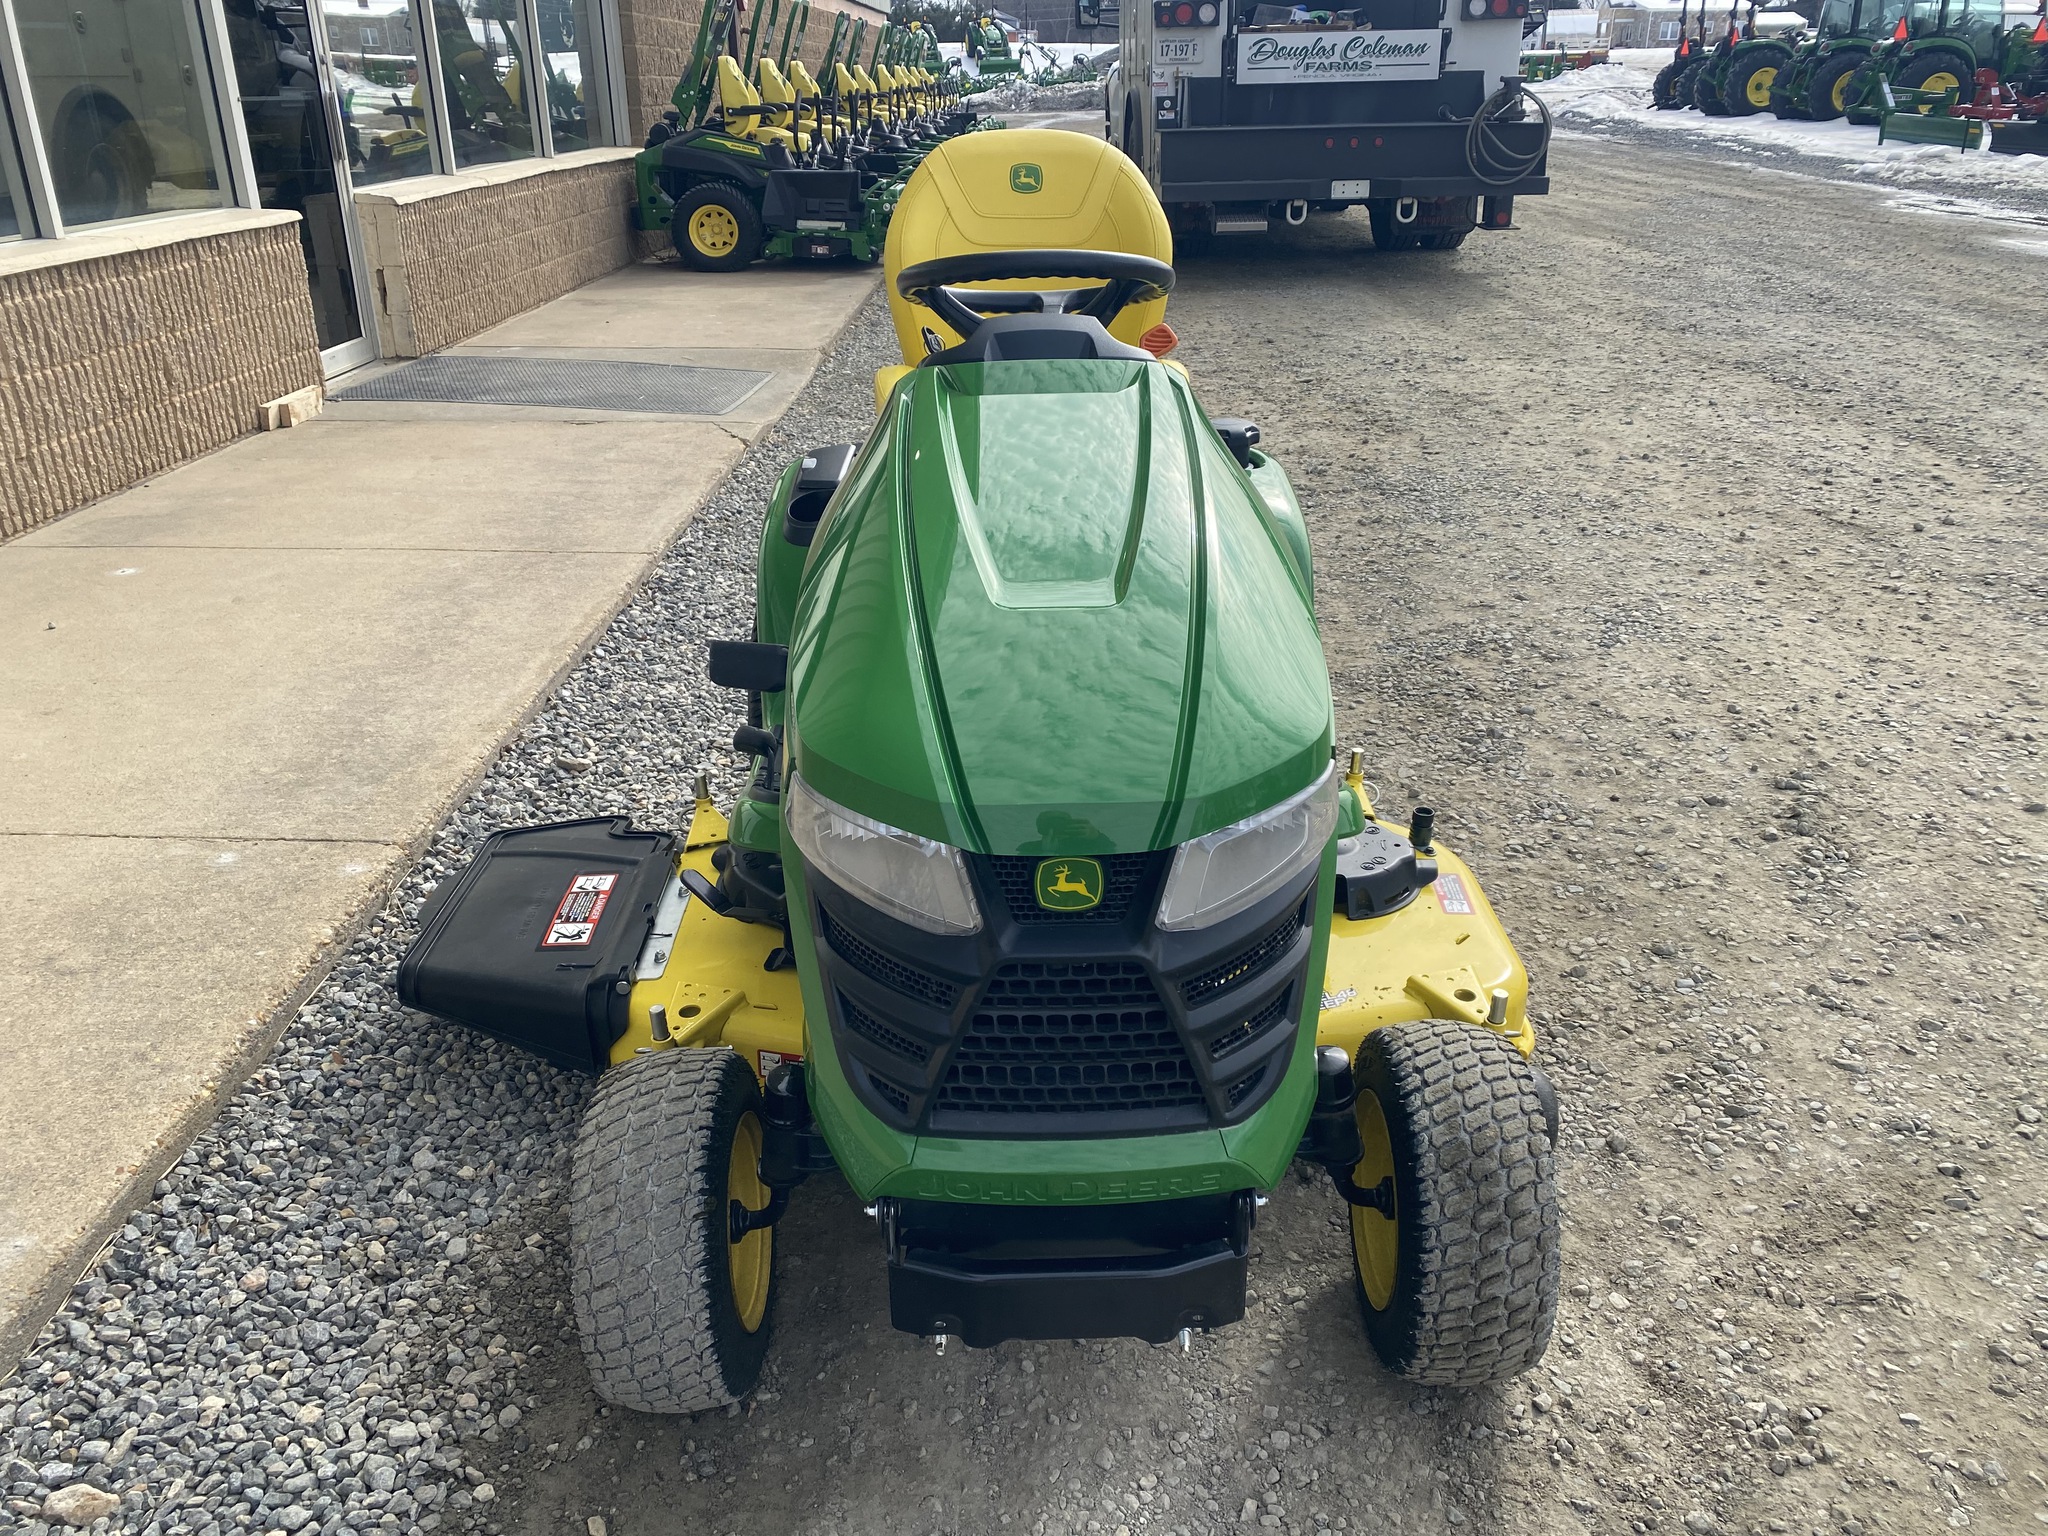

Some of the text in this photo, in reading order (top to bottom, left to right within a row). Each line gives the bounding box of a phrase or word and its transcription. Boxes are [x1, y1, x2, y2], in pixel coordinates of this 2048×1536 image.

[1160, 44, 1190, 57] 17-197
[1248, 35, 1431, 68] Douglas Coleman
[1303, 60, 1373, 72] FARMS
[918, 1172, 1223, 1202] JOHN DEERE
